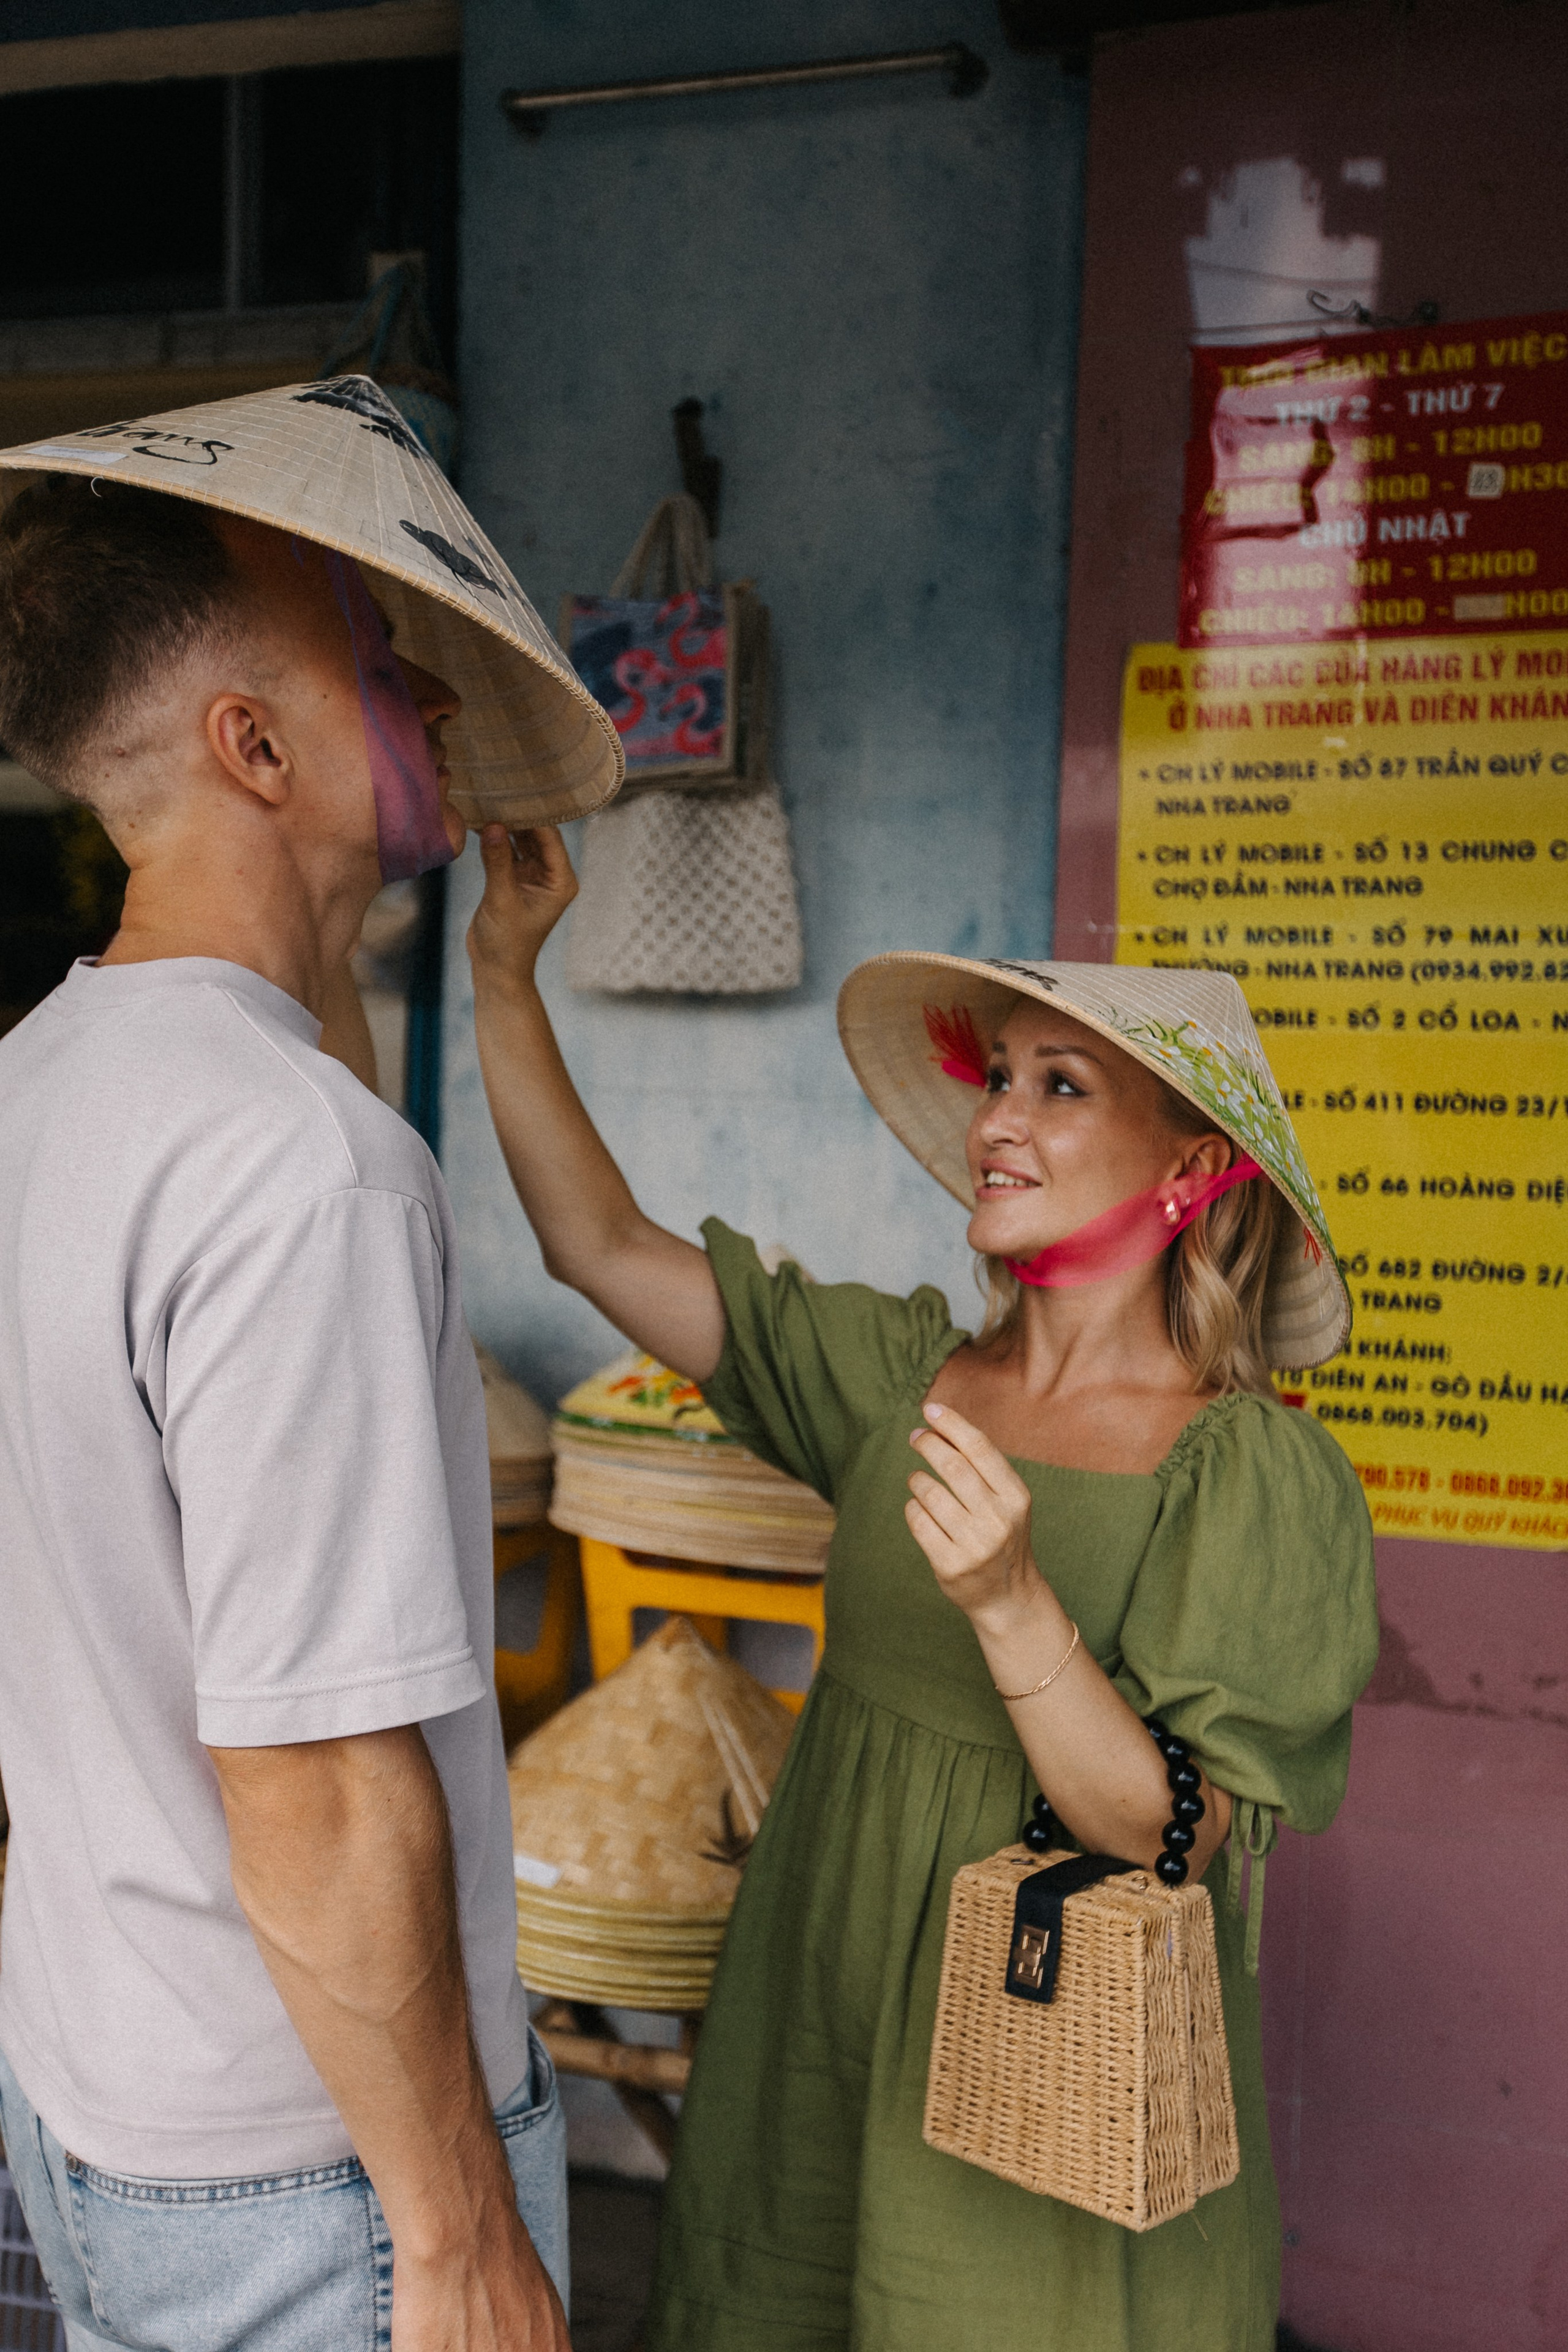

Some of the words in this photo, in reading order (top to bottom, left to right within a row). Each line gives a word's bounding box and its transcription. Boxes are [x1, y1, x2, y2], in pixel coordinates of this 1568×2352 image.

[1398, 339, 1476, 376] LÀM
[1485, 330, 1567, 370] VIỆC
[1348, 394, 1370, 423] 2
[1405, 380, 1476, 417] THỨ
[1483, 382, 1505, 411] 7
[1432, 421, 1544, 457] 12H00
[1298, 512, 1368, 549] CHỦ
[1378, 508, 1472, 546] NHẬT
[1428, 548, 1538, 584] 12H00
[1322, 597, 1427, 630] 14H00
[1248, 658, 1305, 690] CÁC
[1381, 650, 1463, 684] HÀNG
[1472, 644, 1505, 681] LÝ
[1517, 647, 1568, 679] MO
[1195, 702, 1252, 731] NHA
[1262, 698, 1356, 728] TRANG
[1363, 690, 1400, 726] VÀ
[1410, 689, 1479, 725] DIÊN
[1156, 763, 1193, 785] CH
[1199, 757, 1224, 784] LÝ
[1231, 759, 1319, 782] MOBILE
[1337, 748, 1373, 780] SỐ
[1415, 745, 1481, 778] TRẦN
[1487, 747, 1544, 778] QUÝ
[1155, 795, 1207, 816] NHA
[1212, 793, 1292, 816] TRANG
[1154, 844, 1190, 865] CH
[1201, 839, 1227, 865] LÝ
[1237, 842, 1325, 865] MOBILE
[1354, 834, 1389, 864] SỐ
[1401, 839, 1430, 864] 13
[1441, 838, 1537, 863] CHUNG
[1283, 875, 1336, 898] NHA
[1341, 874, 1425, 898] TRANG
[1152, 925, 1188, 947] CH
[1203, 920, 1228, 947] LÝ
[1244, 925, 1335, 948] MOBILE
[1371, 917, 1408, 948] SỐ
[1423, 924, 1454, 947] 79
[1469, 924, 1520, 946] MAI
[1266, 959, 1319, 980] NHA
[1324, 959, 1405, 981] TRANG
[1346, 1000, 1381, 1031] SỐ
[1392, 1007, 1406, 1031] 2
[1470, 1008, 1521, 1032] LOA
[1324, 1083, 1358, 1112] SỐ
[1364, 1091, 1404, 1114] 411
[1414, 1087, 1509, 1117] ĐƯỜNG
[1336, 1165, 1370, 1194] SỐ
[1420, 1171, 1516, 1201] HOÀNG
[1431, 1255, 1526, 1285] ĐƯỜNG
[1360, 1288, 1442, 1315] TRANG
[1311, 1366, 1365, 1390] DIÊN
[1374, 1374, 1408, 1393] AN
